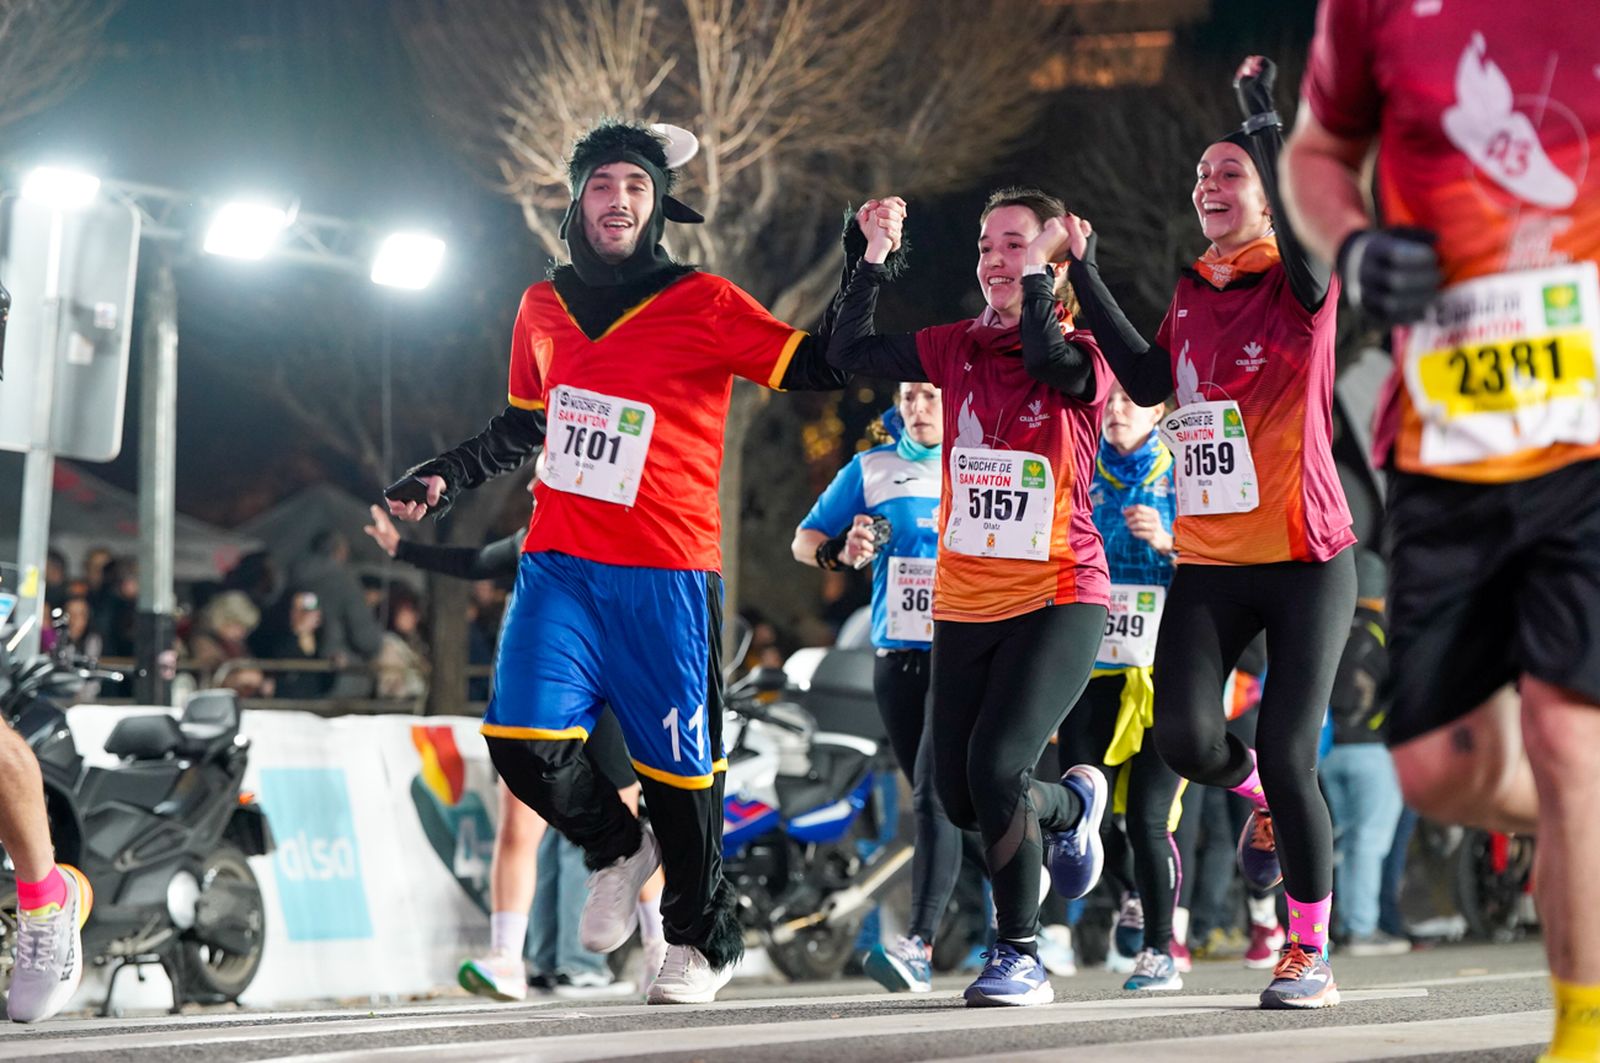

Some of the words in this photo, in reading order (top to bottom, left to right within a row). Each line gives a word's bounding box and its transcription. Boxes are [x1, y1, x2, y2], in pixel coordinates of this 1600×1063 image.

[1449, 337, 1562, 396] 2381
[1204, 414, 1214, 426] DE
[563, 424, 622, 465] 7601
[1184, 441, 1235, 477] 5159
[959, 473, 975, 485] SAN
[976, 472, 1011, 487] ANTÓN
[968, 460, 998, 472] NOCHE
[999, 463, 1012, 473] DE
[968, 487, 1029, 522] 5157
[898, 577, 913, 586] SAN
[662, 704, 705, 762] 11
[278, 829, 356, 882] alsa
